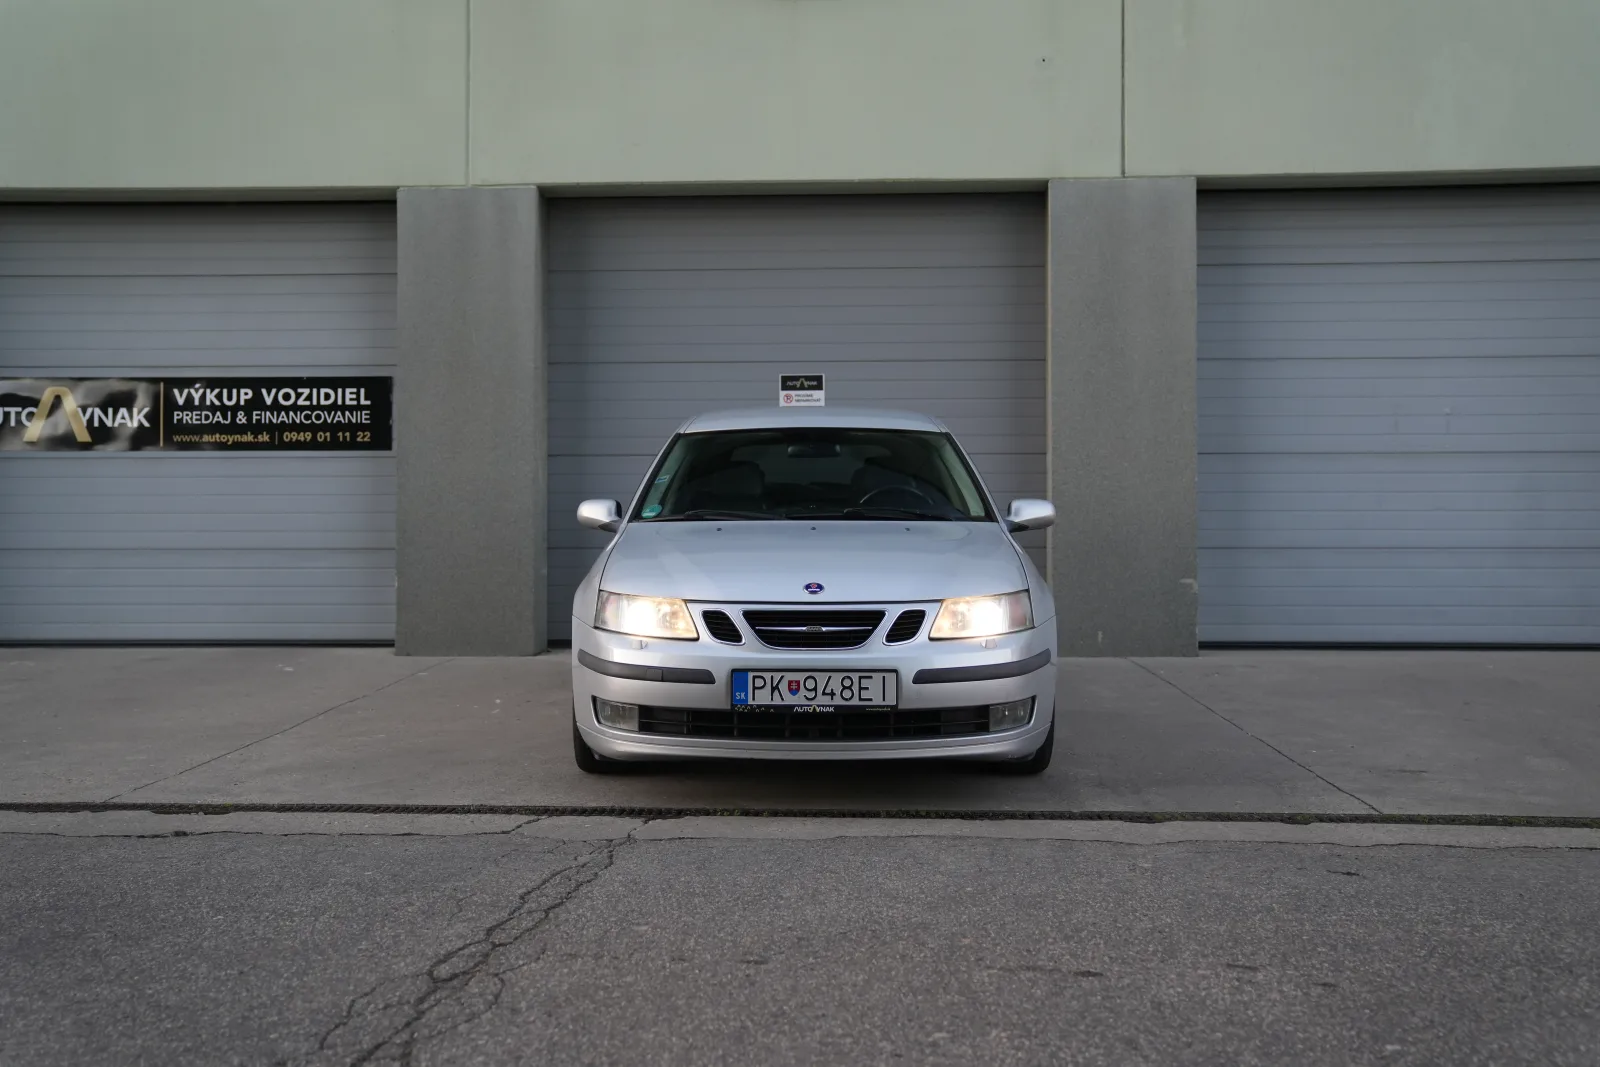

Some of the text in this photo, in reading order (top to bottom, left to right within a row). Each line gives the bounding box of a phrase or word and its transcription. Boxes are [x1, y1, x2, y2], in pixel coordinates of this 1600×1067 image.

[173, 383, 371, 405] VÝKUP VOZIDIEL
[173, 411, 371, 424] PREDAJ & FINANCOVANIE
[173, 431, 371, 445] www.autoynak.sk 0949 01 11 22
[735, 692, 746, 700] SK
